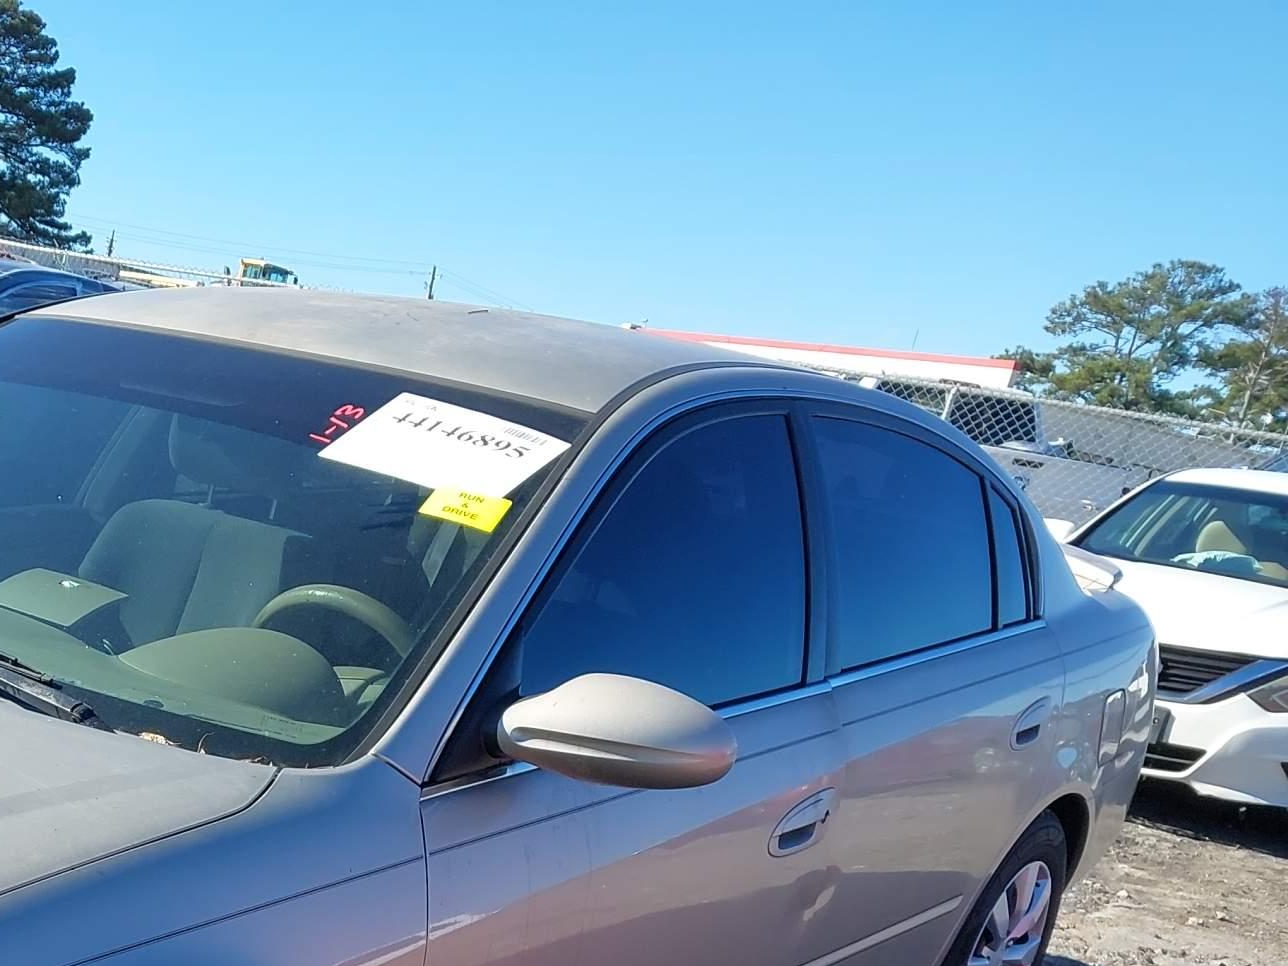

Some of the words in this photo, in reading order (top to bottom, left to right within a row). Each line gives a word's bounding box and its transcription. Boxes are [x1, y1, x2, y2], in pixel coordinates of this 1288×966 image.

[309, 404, 364, 443] 1-13
[392, 412, 531, 458] 44146895
[459, 492, 485, 503] RUN
[442, 506, 480, 520] DRIVE
